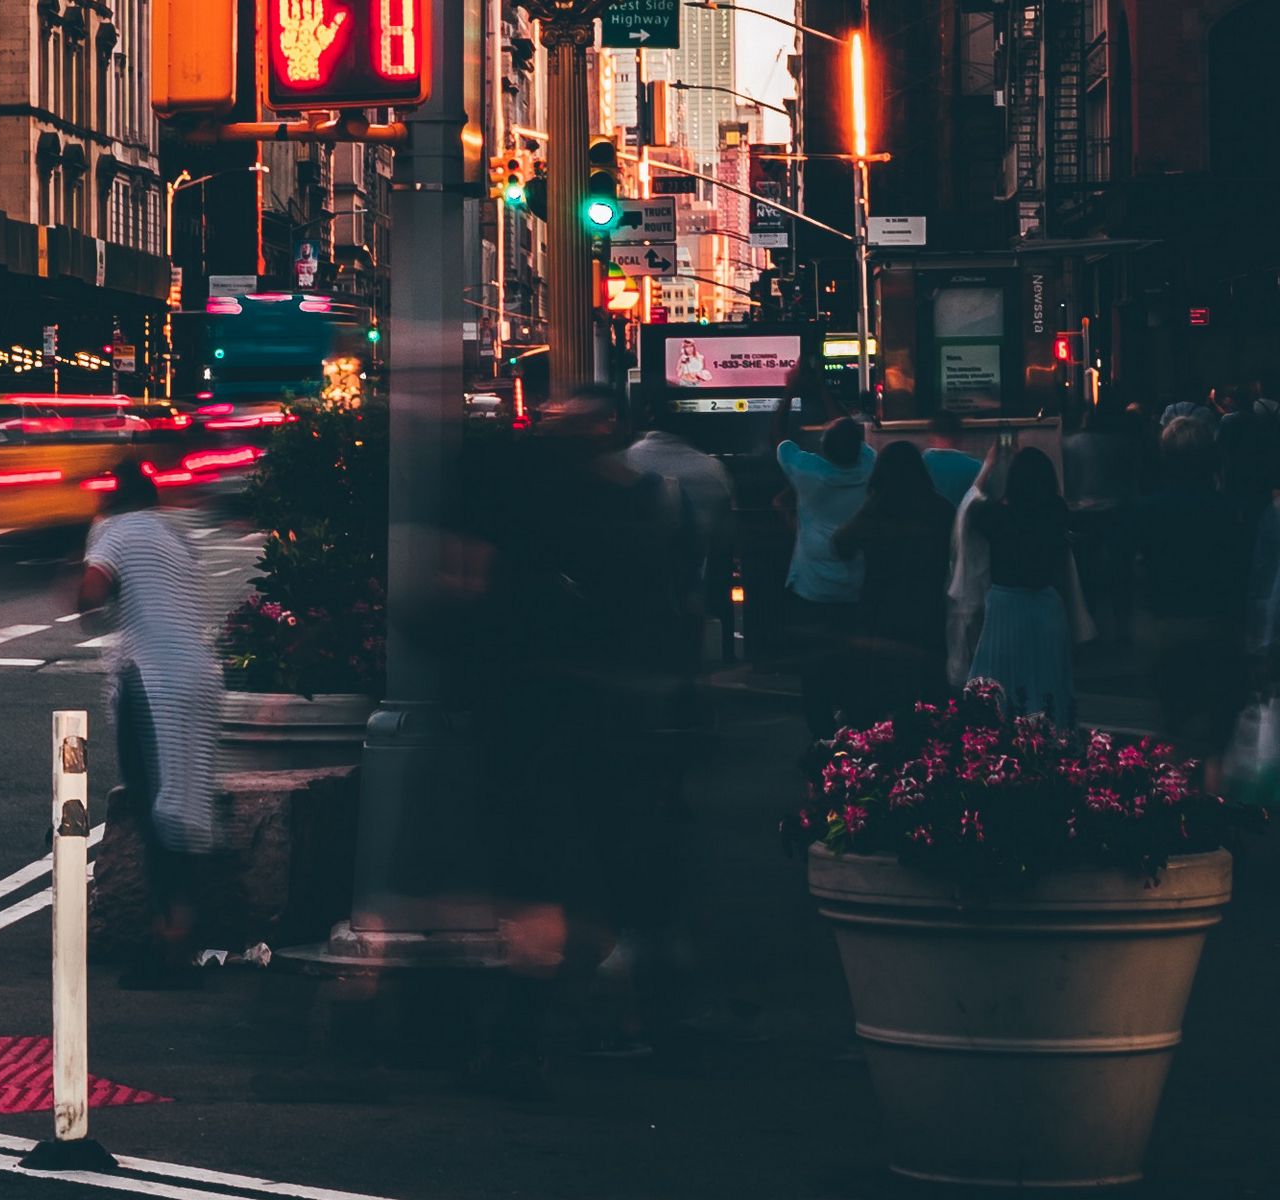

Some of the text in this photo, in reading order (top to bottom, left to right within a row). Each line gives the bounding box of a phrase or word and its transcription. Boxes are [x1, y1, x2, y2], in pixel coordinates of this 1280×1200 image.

[646, 0, 674, 11] Side
[611, 14, 670, 28] Highway
[644, 207, 672, 217] TRUCK
[644, 222, 673, 232] ROUTE
[613, 256, 640, 265] LOCAL
